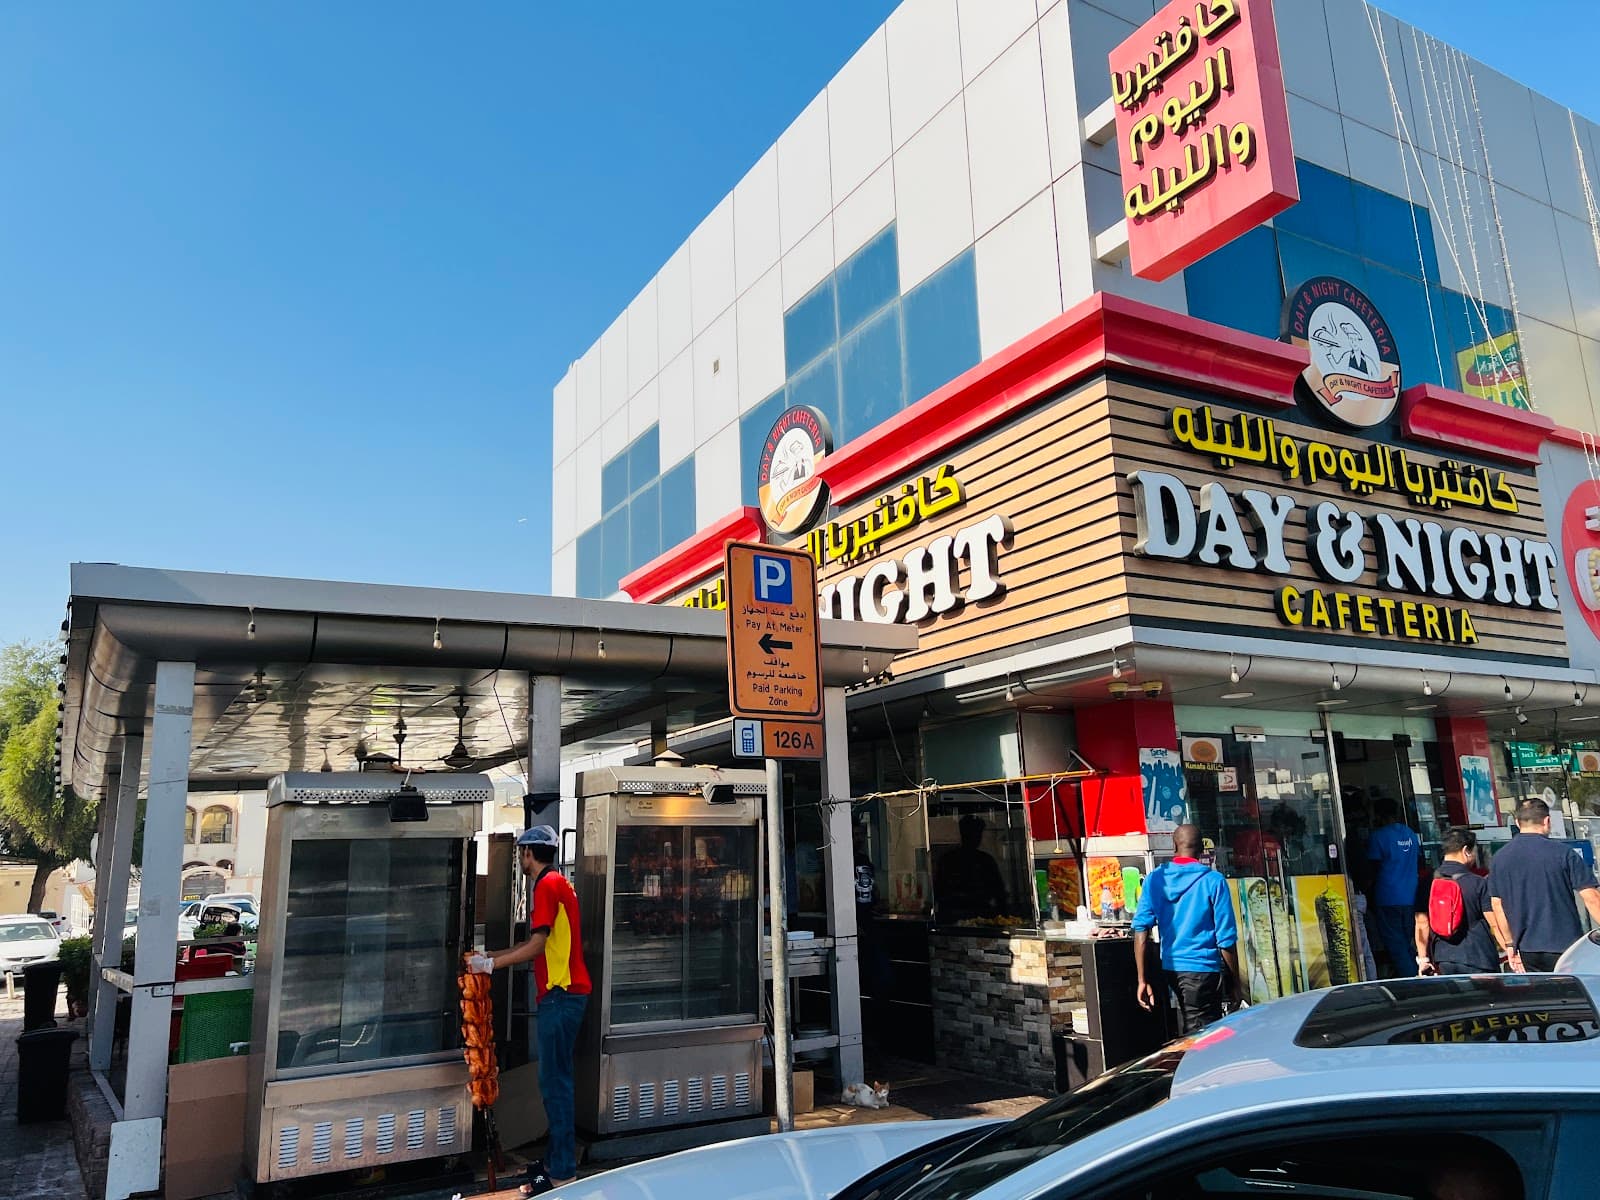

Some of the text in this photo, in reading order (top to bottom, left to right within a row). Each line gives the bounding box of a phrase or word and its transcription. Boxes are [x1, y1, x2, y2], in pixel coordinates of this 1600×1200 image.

[1131, 47, 1233, 163] اليوم
[1125, 121, 1256, 219] والليله
[1294, 281, 1391, 355] DAY & NIGHT CAFETERIA
[762, 453, 771, 481] DAY
[772, 414, 792, 441] NIGHT
[792, 409, 823, 448] CAFETERIA
[1170, 404, 1519, 513] كافتيريا اليوم والليله
[827, 464, 966, 566] كافتيريا
[1129, 470, 1296, 575] DAY
[1307, 500, 1365, 584] &
[1369, 512, 1558, 609] NIGHT
[759, 559, 788, 600] P
[746, 619, 803, 633] Pay At Meter
[1275, 584, 1481, 645] CAFETERIA
[746, 668, 775, 680] للرسوم
[752, 683, 803, 697] Paid Parking
[763, 657, 790, 669] مواقف
[768, 696, 788, 707] Zone
[773, 730, 815, 750] 126A
